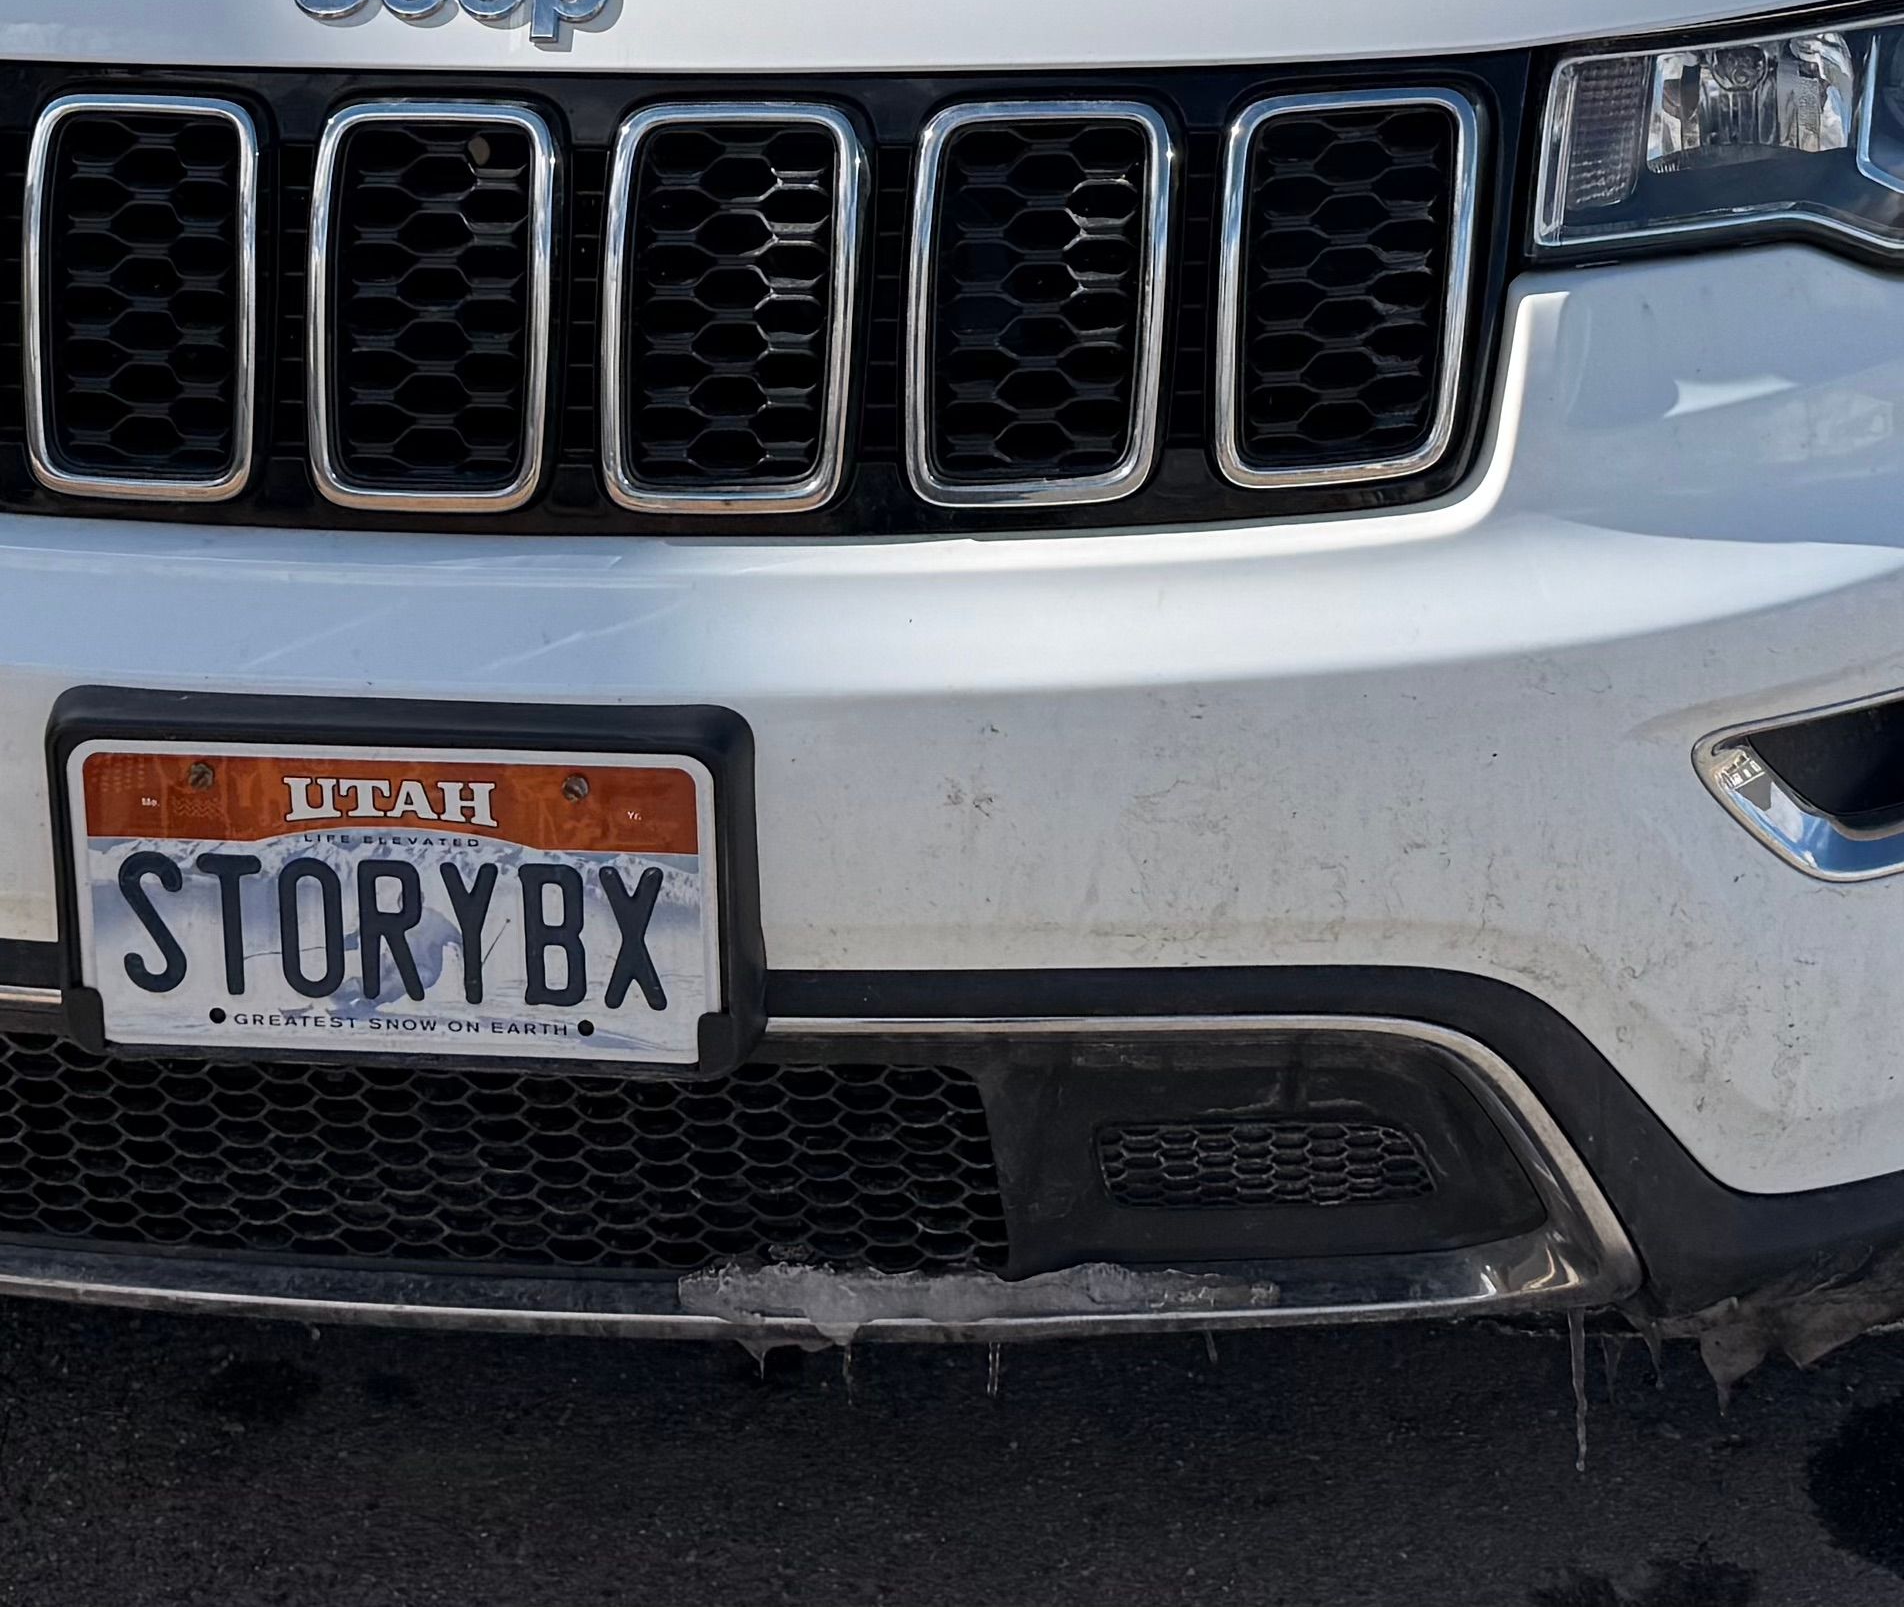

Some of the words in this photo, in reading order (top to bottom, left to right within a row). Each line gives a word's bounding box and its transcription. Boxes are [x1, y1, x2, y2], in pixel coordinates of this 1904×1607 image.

[283, 776, 499, 828] UTAH
[303, 833, 350, 844] LIFE
[363, 835, 480, 847] ELEVATED
[118, 850, 669, 1012] STORYBX
[234, 1013, 357, 1029] GREATEST
[368, 1017, 438, 1032] SNOW
[448, 1020, 480, 1033] ON
[491, 1021, 568, 1036] EARTH
